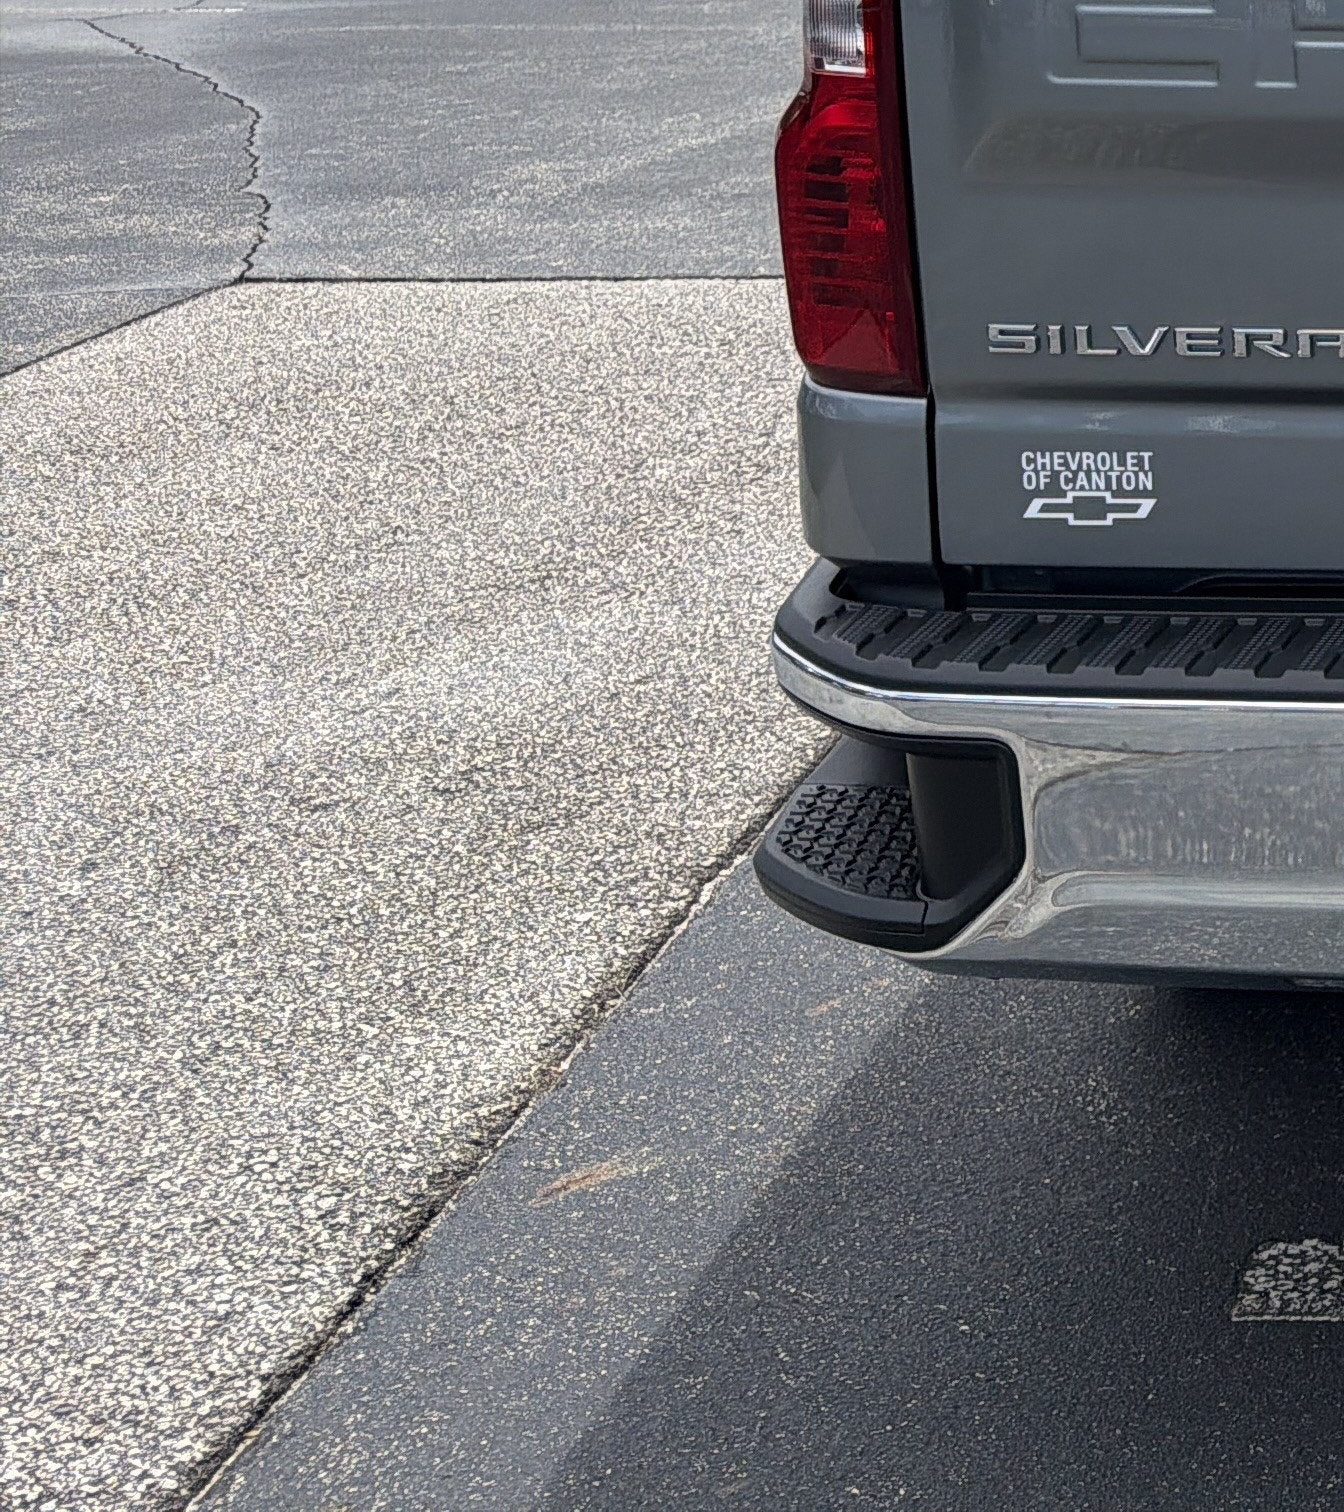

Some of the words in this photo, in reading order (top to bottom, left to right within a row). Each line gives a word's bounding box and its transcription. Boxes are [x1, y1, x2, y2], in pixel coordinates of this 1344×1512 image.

[1021, 451, 1154, 472] CHEVROLET
[1022, 471, 1051, 491] OF
[1060, 471, 1154, 491] CANTON
